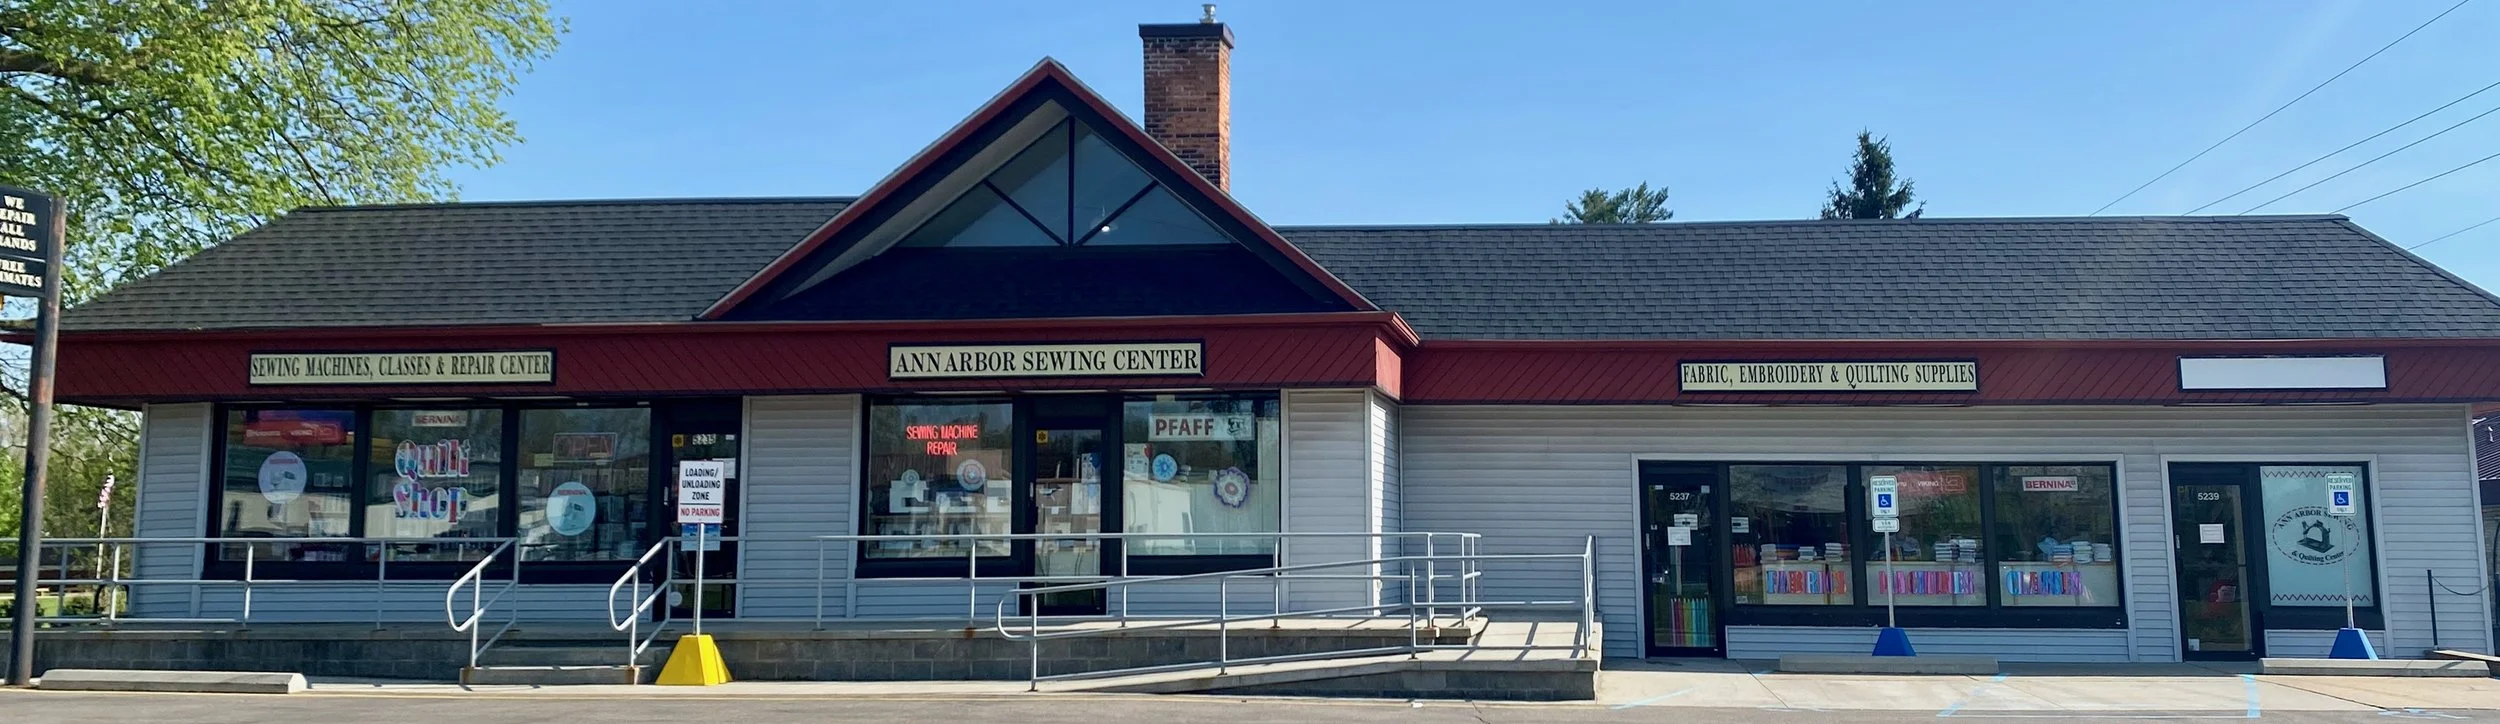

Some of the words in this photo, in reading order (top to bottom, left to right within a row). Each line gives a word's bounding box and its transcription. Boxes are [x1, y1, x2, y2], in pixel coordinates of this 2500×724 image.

[4, 195, 24, 210] WE
[0, 208, 36, 225] EPAIR
[0, 221, 25, 236] ALL
[0, 235, 37, 252] ANDS
[0, 259, 26, 273] REE
[0, 271, 42, 288] IMATES
[251, 356, 300, 377] SEWING
[304, 356, 374, 380] MACHINES,
[378, 356, 431, 376] CLASSES
[435, 356, 445, 375] &
[451, 355, 495, 375] REPAIR
[499, 354, 551, 375] CENTER
[895, 352, 941, 373] ANN
[944, 351, 1016, 372] ARBOR
[1022, 350, 1106, 372] SEWING
[1113, 349, 1199, 371] CENTER
[1683, 364, 1734, 387] FABRIC,
[1739, 364, 1824, 383] EMBROIDERY
[1830, 365, 1840, 383] &
[1845, 364, 1910, 389] QUILTING
[1915, 364, 1975, 383] SUPPLIES
[906, 425, 939, 440] SEWING
[941, 424, 979, 440] MACHINE
[1155, 418, 1214, 436] PFAFF
[927, 441, 957, 456] REPAIR
[395, 439, 471, 481] Quilt
[685, 467, 719, 478] LOADING/
[682, 479, 720, 489] UNLOADING
[2024, 480, 2072, 489] BERNINA
[393, 482, 469, 524] Shop
[692, 491, 710, 501] ZONE
[1669, 492, 1690, 501] 5237
[2197, 492, 2220, 501] 5239
[680, 507, 690, 516] NO
[692, 508, 720, 517] PARKING
[2278, 516, 2292, 529] ANN
[2295, 510, 2321, 518] ARBOR
[2299, 553, 2324, 562] Quilting
[2325, 551, 2344, 560] Center
